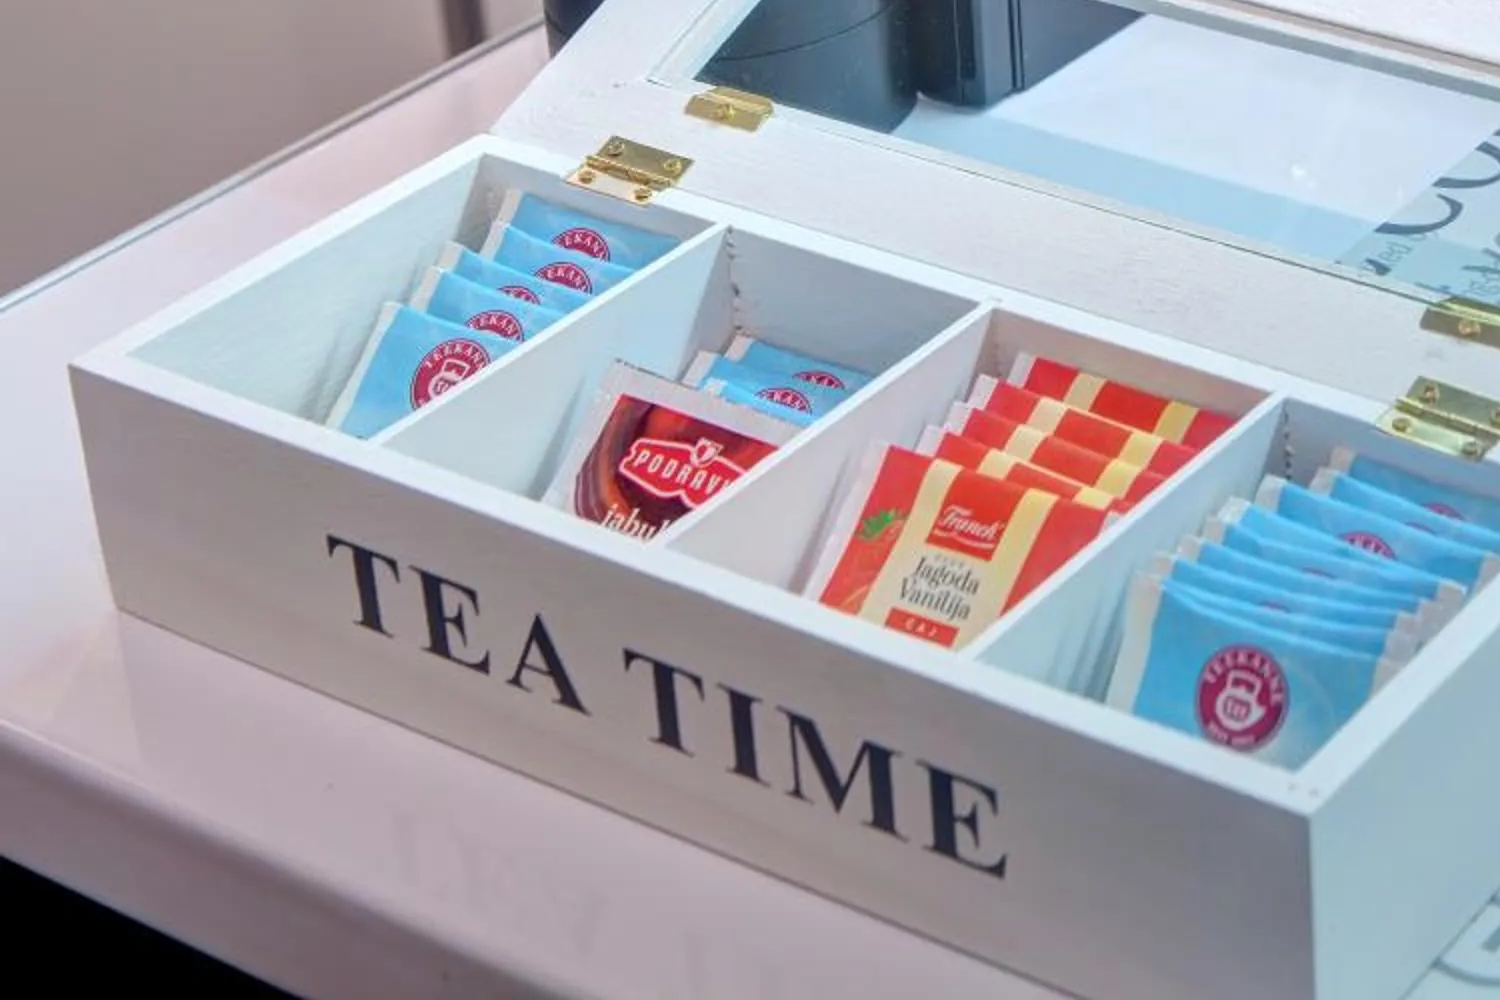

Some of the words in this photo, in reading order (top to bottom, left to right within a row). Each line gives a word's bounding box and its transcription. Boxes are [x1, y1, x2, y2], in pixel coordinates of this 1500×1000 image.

[623, 449, 730, 495] PODRAV
[915, 556, 981, 596] Jagoda
[326, 533, 593, 718] TEA
[622, 646, 1009, 880] TIME
